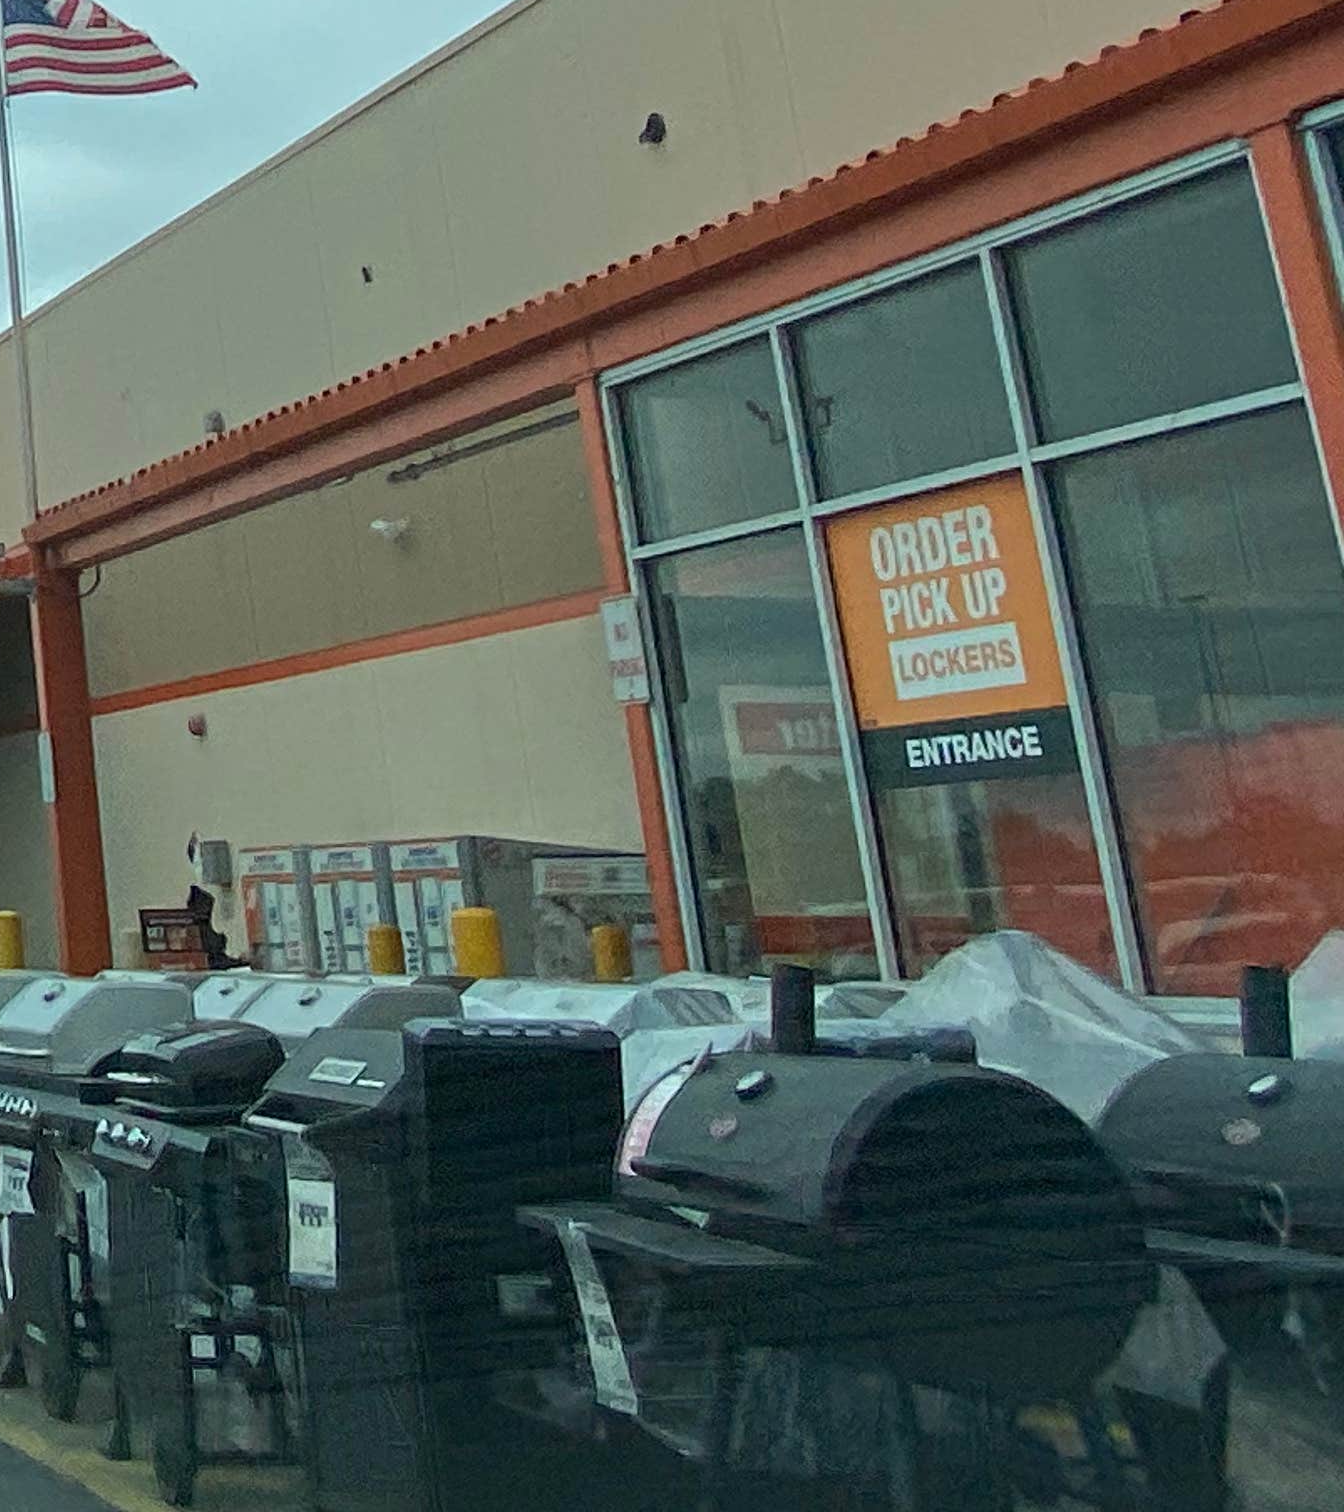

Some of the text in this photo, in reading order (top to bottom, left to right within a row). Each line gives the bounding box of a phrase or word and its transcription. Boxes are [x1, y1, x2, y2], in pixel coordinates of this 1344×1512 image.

[870, 505, 999, 581] ORDER
[880, 567, 1006, 634] PICK UP
[898, 639, 1017, 683] LOCKERS
[906, 725, 1043, 768] ENTRANCE
